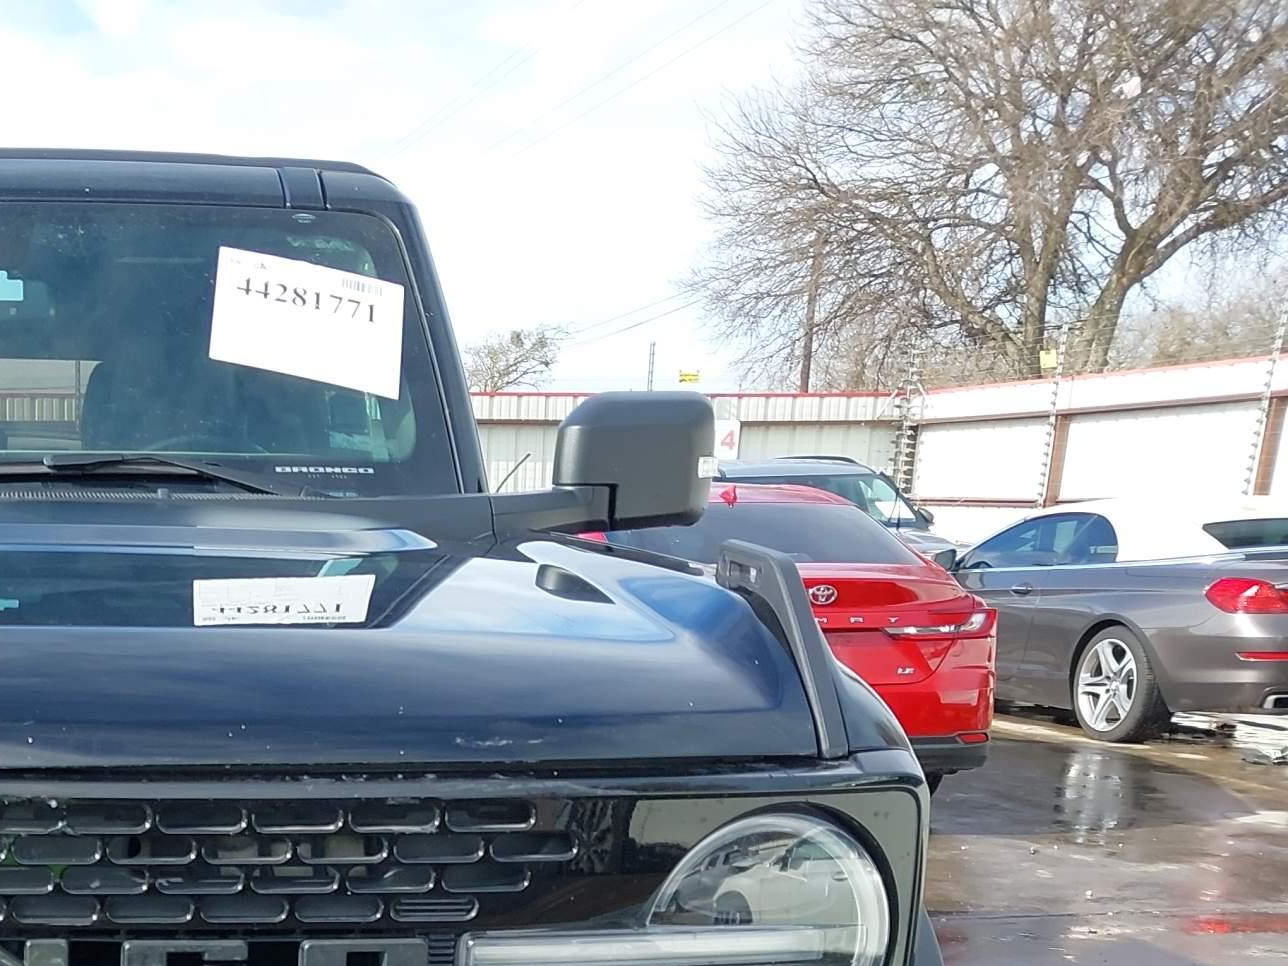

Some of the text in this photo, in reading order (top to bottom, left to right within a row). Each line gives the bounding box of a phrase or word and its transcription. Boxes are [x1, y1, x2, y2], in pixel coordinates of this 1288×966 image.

[236, 277, 375, 323] 44281771
[720, 430, 736, 450] 4
[275, 466, 375, 475] BRONCO
[814, 616, 899, 624] MRY
